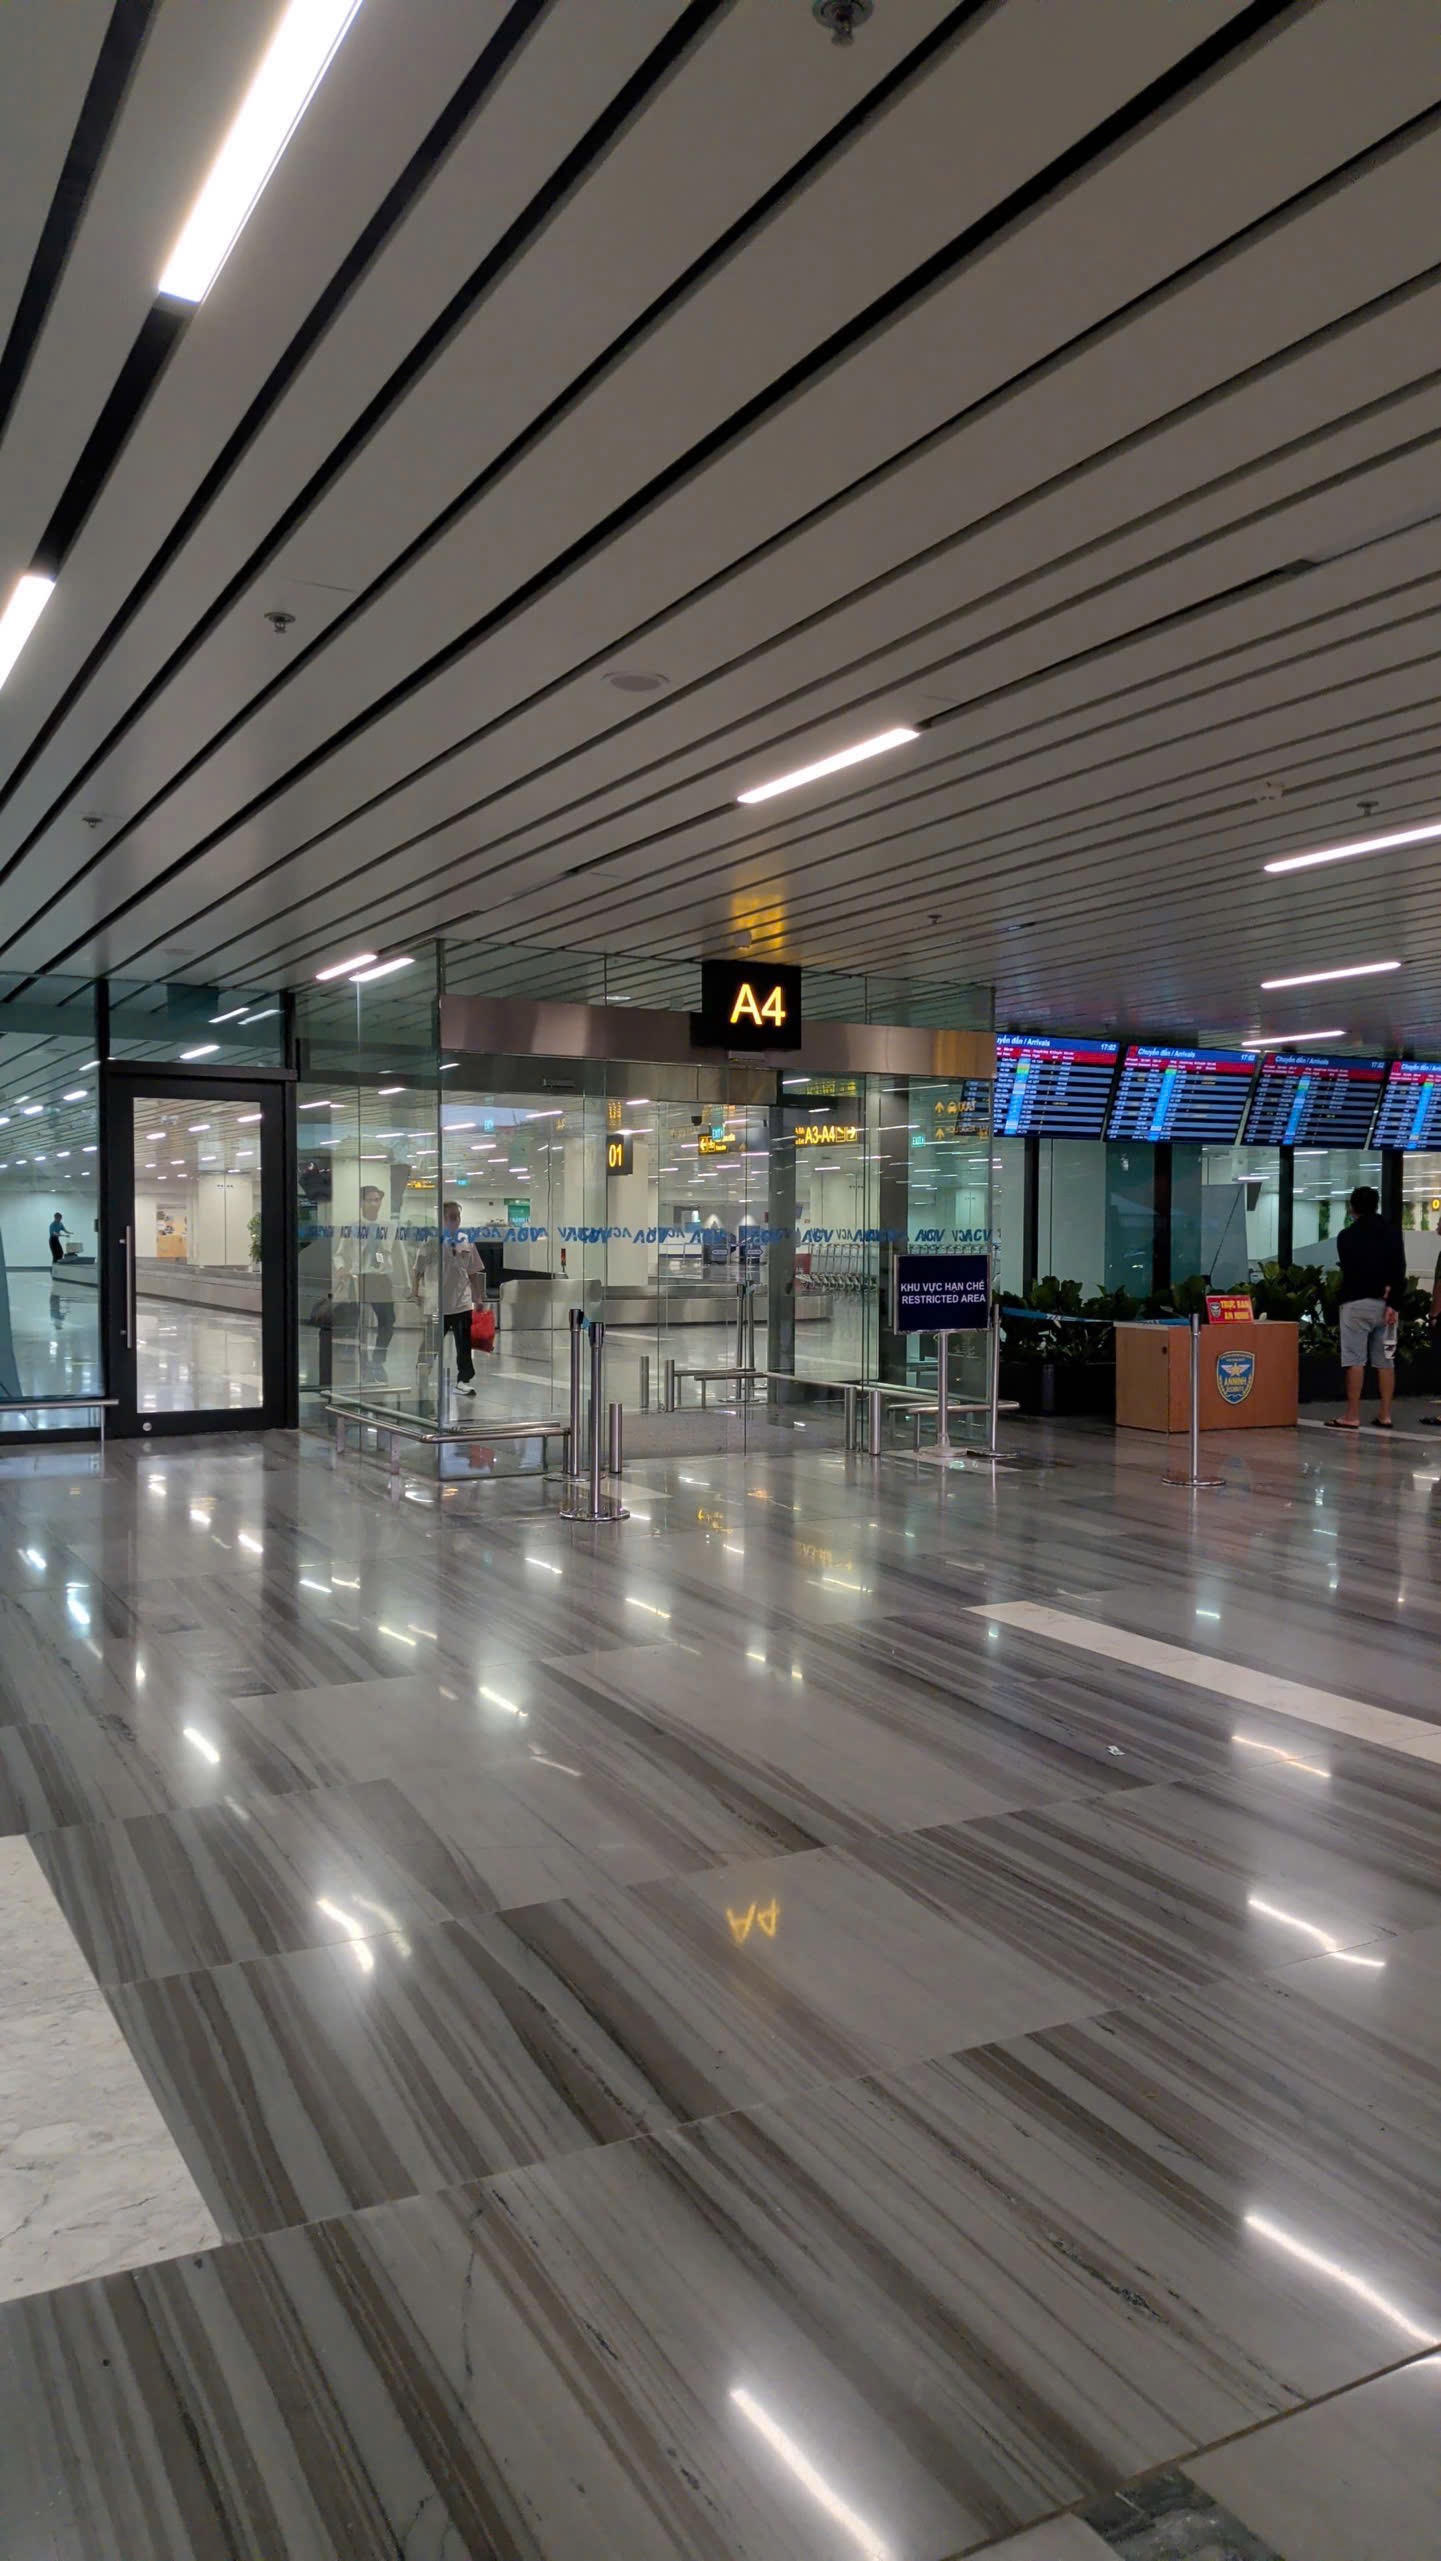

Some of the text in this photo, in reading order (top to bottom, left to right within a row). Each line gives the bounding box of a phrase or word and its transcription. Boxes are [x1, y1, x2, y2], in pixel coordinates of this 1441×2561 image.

[730, 983, 786, 1026] A4
[1027, 1038, 1050, 1047] Arrivals
[1101, 1043, 1117, 1051] 17:02
[1174, 1051, 1196, 1060] Arrivals
[805, 1125, 836, 1145] A3-A4
[608, 1143, 622, 1168] 01
[900, 1282, 920, 1292] KHU
[922, 1282, 942, 1294] VỰC
[944, 1282, 964, 1293] HẠN
[901, 1293, 986, 1304] RESTRICTED AREA
